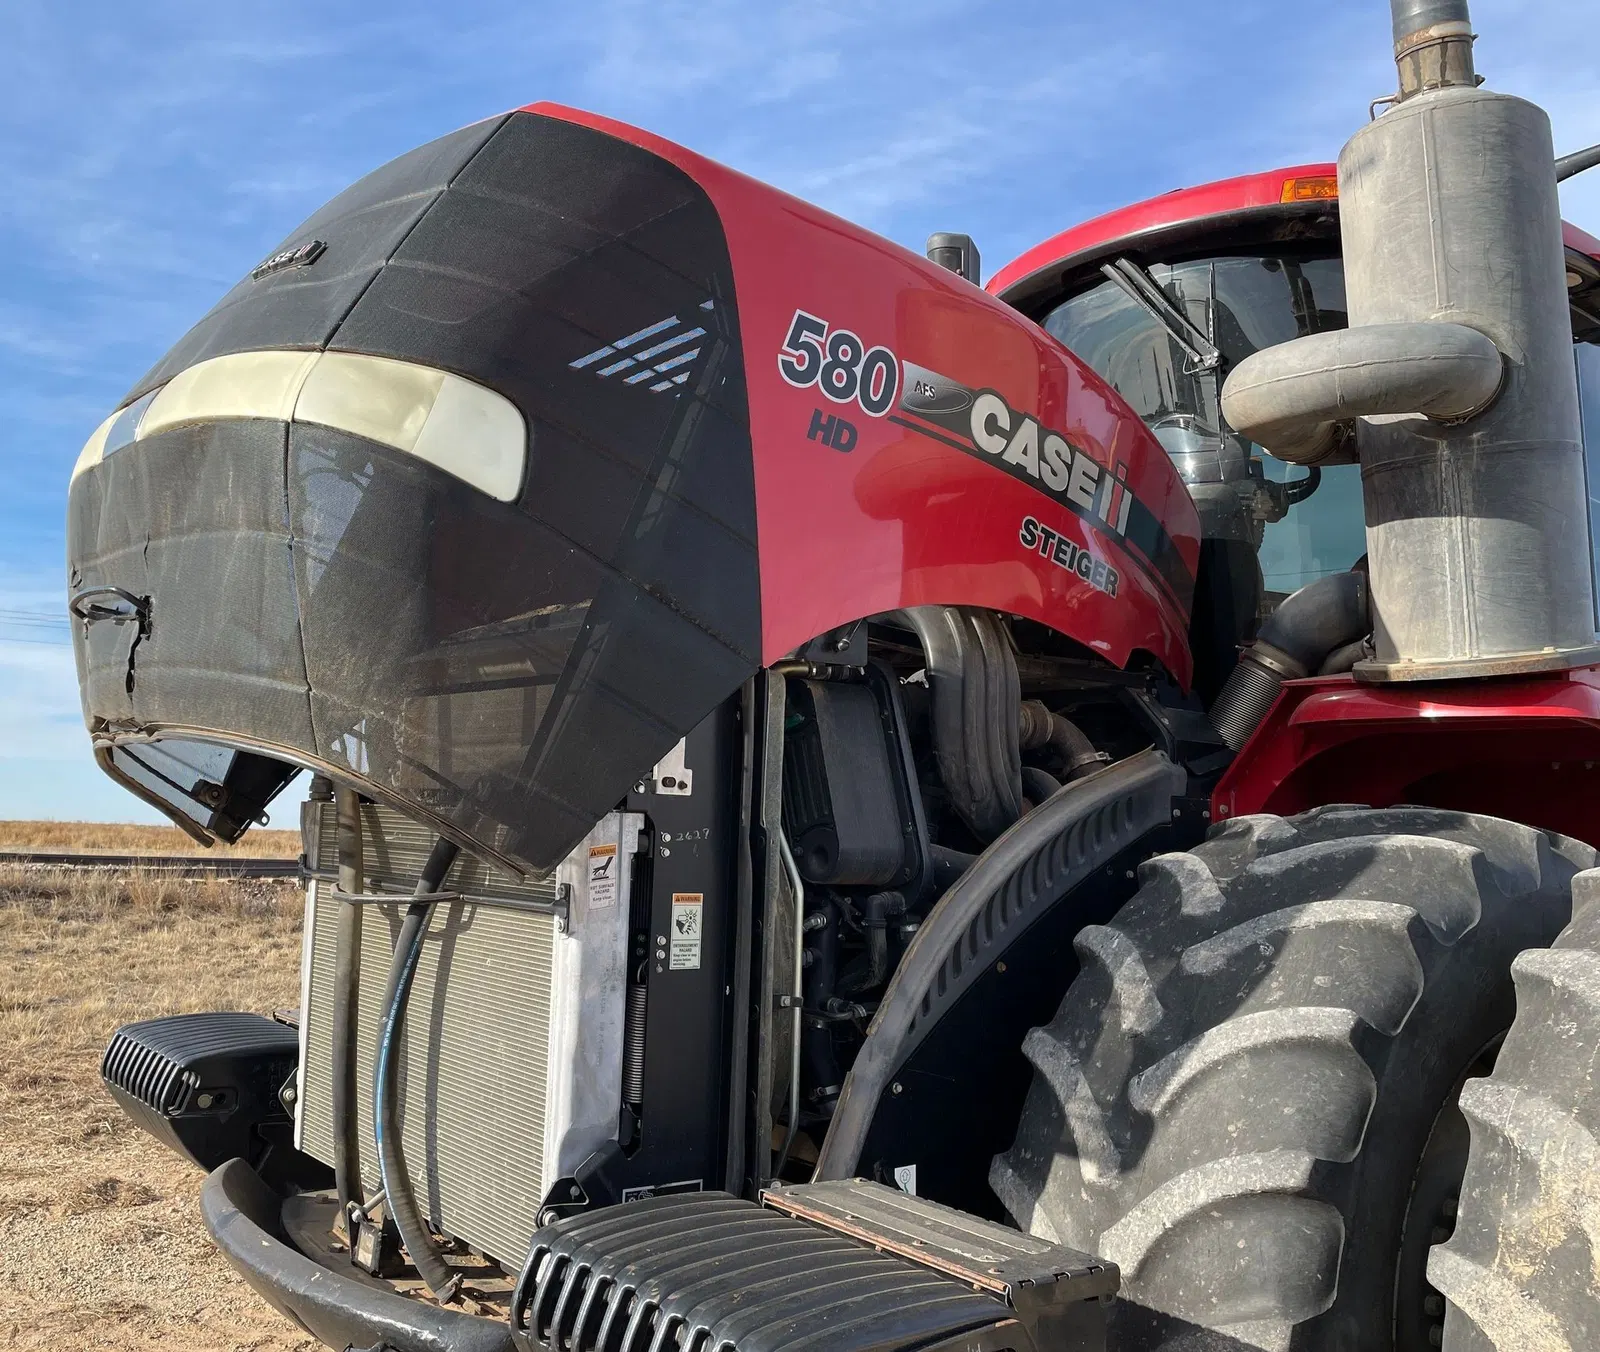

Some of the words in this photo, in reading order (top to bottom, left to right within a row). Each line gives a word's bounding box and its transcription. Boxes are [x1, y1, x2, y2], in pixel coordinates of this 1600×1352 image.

[777, 309, 899, 417] 580
[914, 380, 936, 400] AFS
[806, 408, 858, 453] HD
[970, 393, 1100, 511] CASE
[1019, 515, 1119, 599] STEIGER
